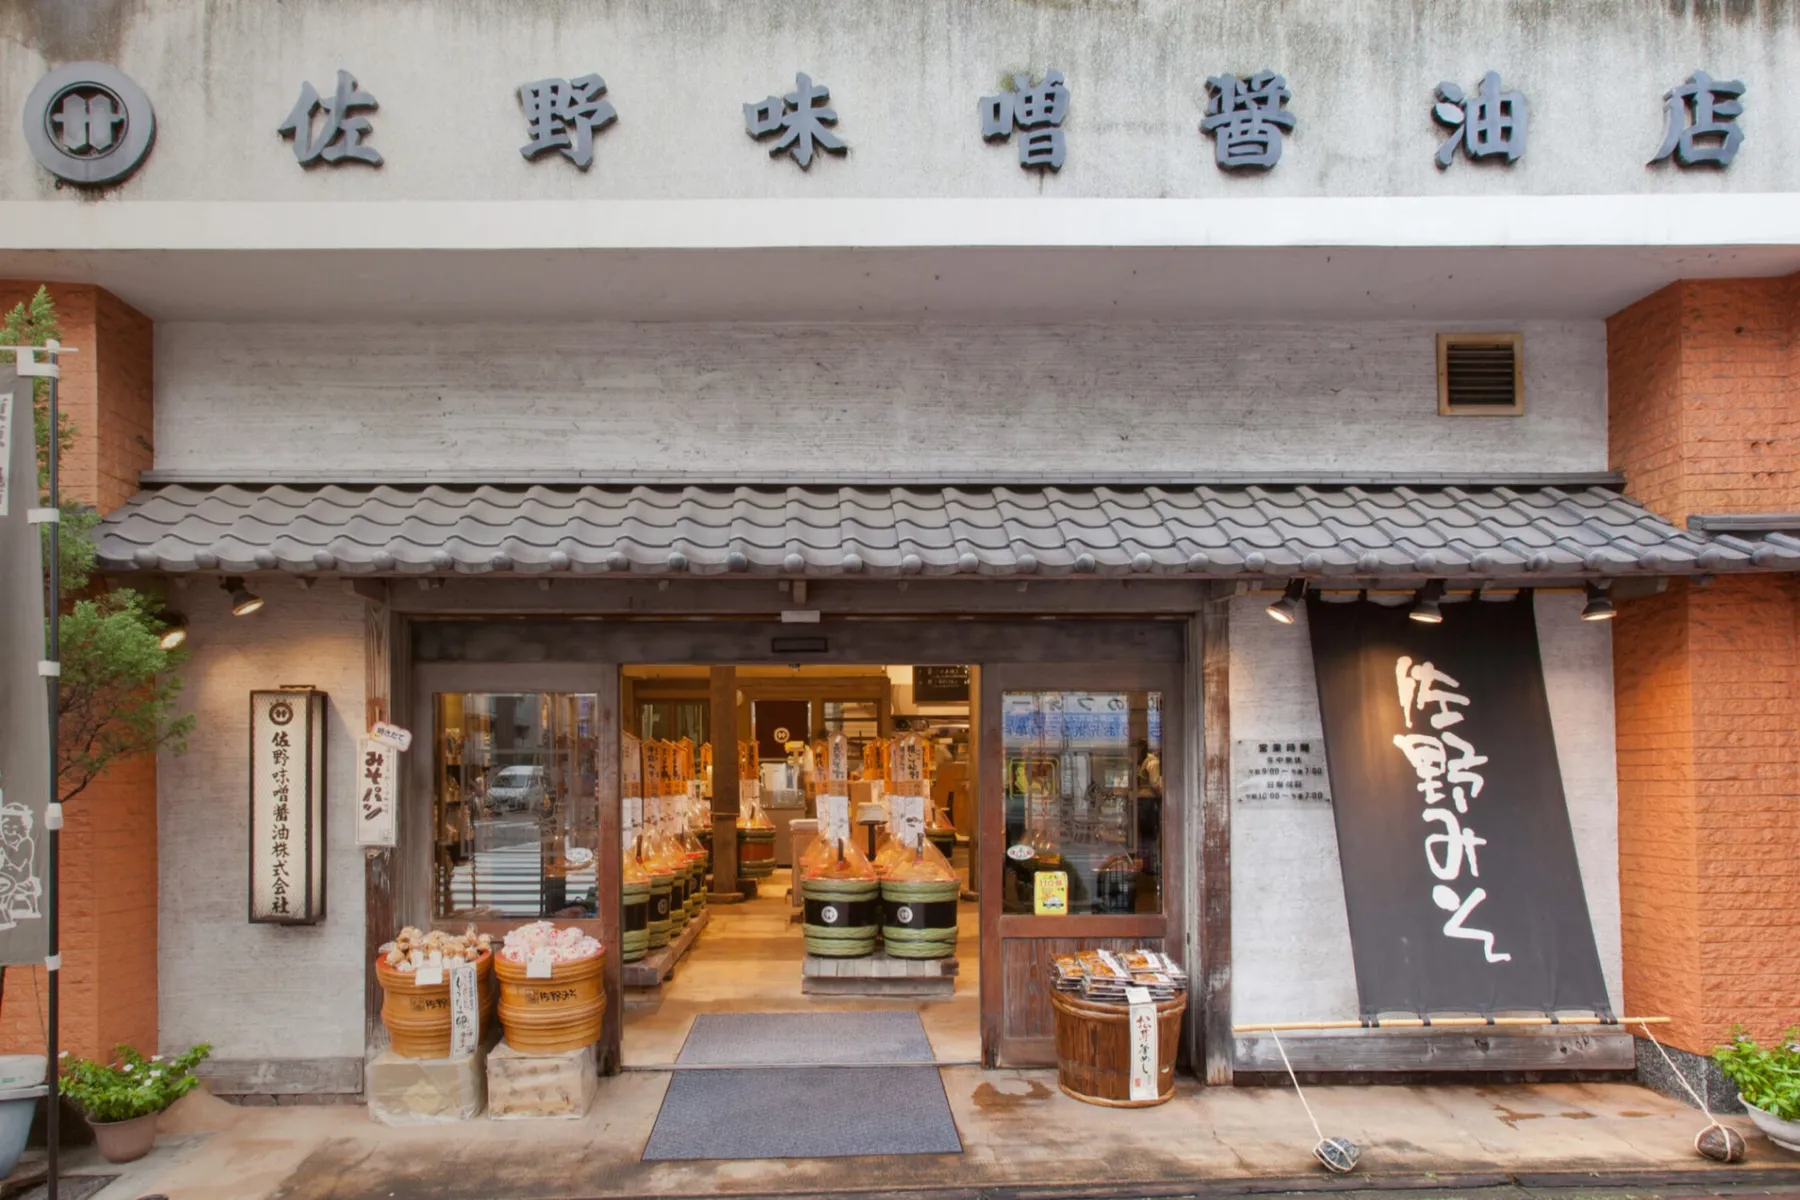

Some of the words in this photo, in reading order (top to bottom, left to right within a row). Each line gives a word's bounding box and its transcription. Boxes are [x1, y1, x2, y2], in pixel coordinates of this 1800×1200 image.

[278, 69, 1746, 171] 佐野味噌醤油店
[1393, 656, 1512, 963] 佐野みそ
